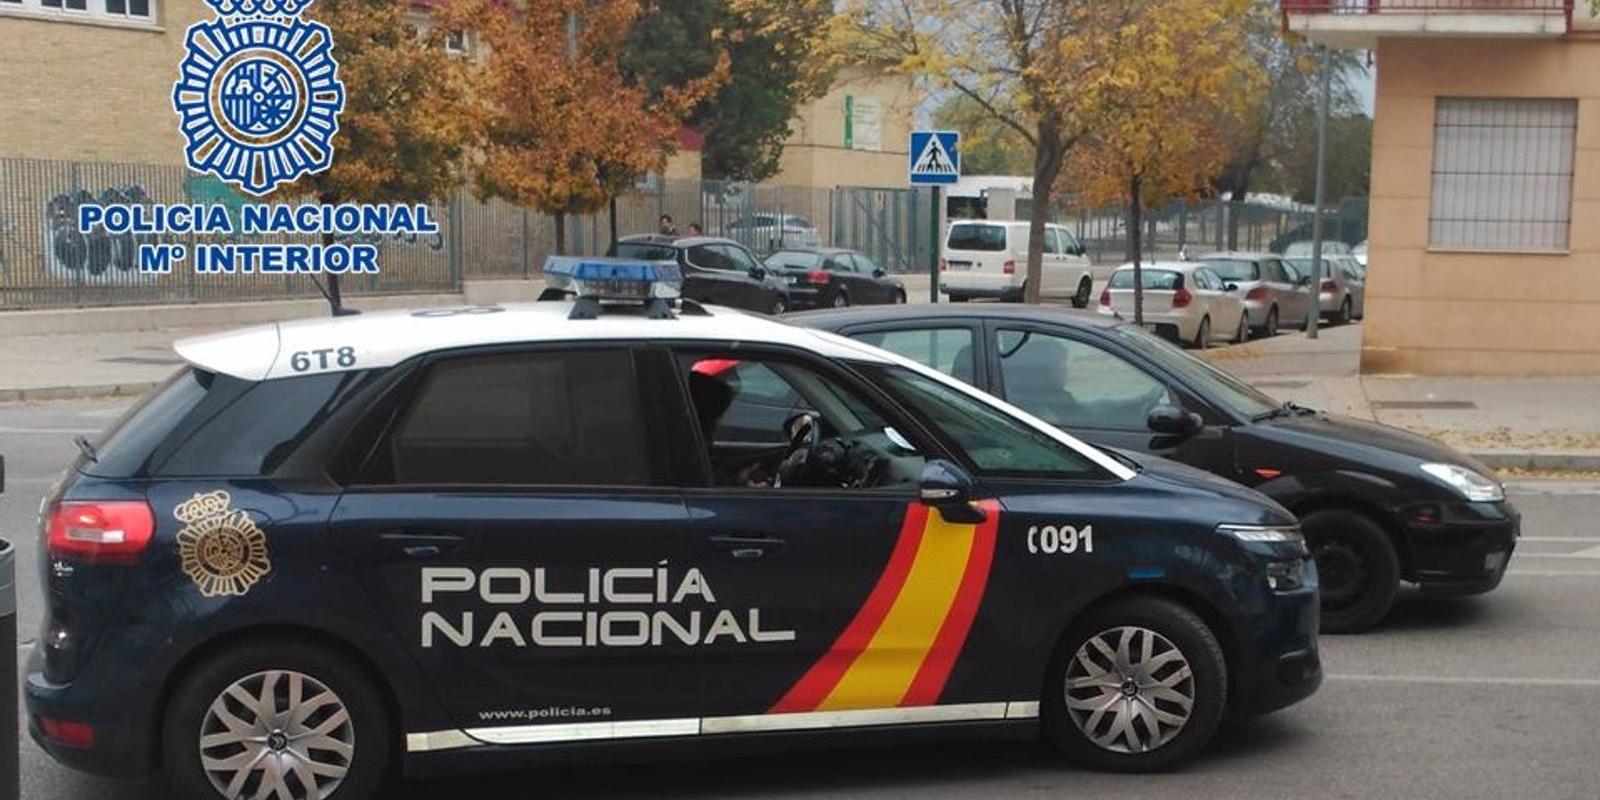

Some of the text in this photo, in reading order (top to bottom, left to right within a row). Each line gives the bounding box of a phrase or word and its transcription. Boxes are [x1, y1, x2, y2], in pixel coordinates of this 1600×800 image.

[290, 346, 356, 372] 6T8
[1040, 525, 1093, 554] 091
[421, 559, 716, 604] POLICÍA
[421, 608, 796, 648] NACIONAL
[479, 706, 612, 720] www.policia.es
